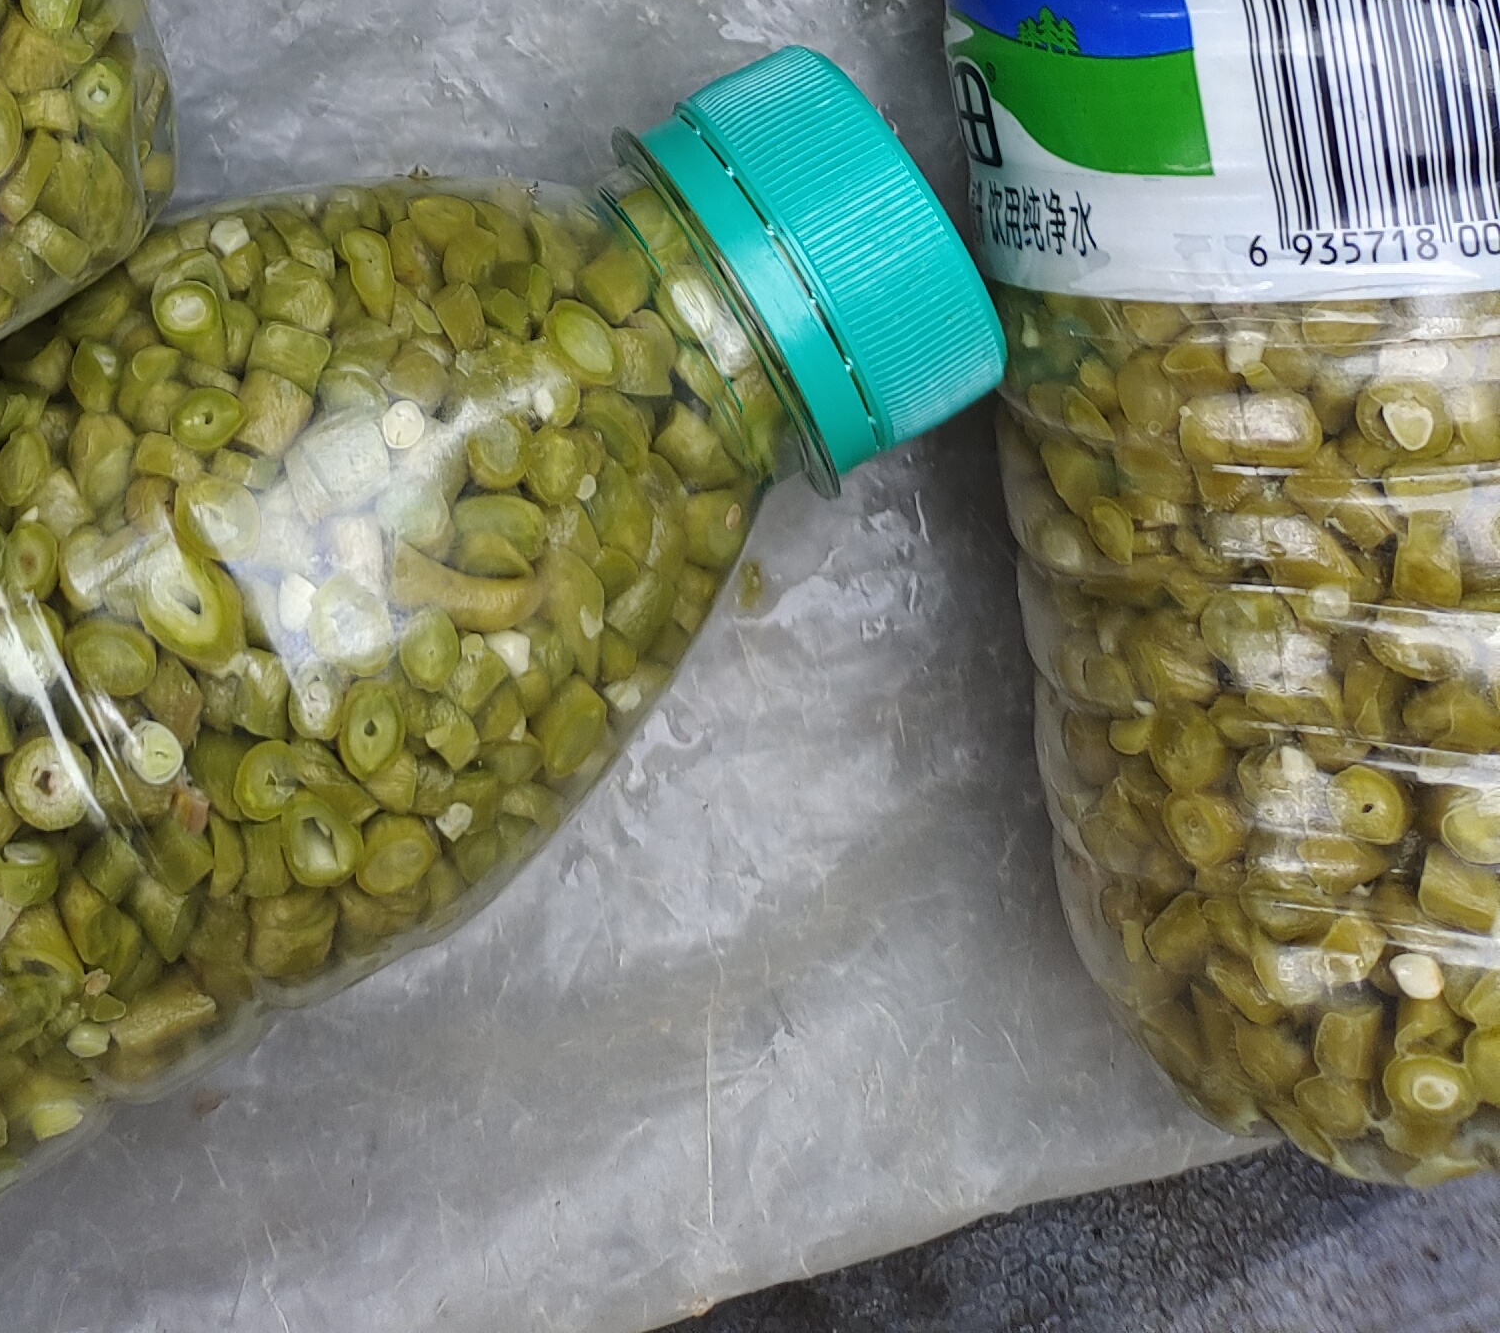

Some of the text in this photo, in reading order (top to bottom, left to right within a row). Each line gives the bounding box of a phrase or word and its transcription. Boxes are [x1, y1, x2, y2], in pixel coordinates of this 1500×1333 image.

[987, 180, 1098, 257] 饮用纯净水
[1249, 234, 1268, 267] 6
[1292, 227, 1439, 266] 935718
